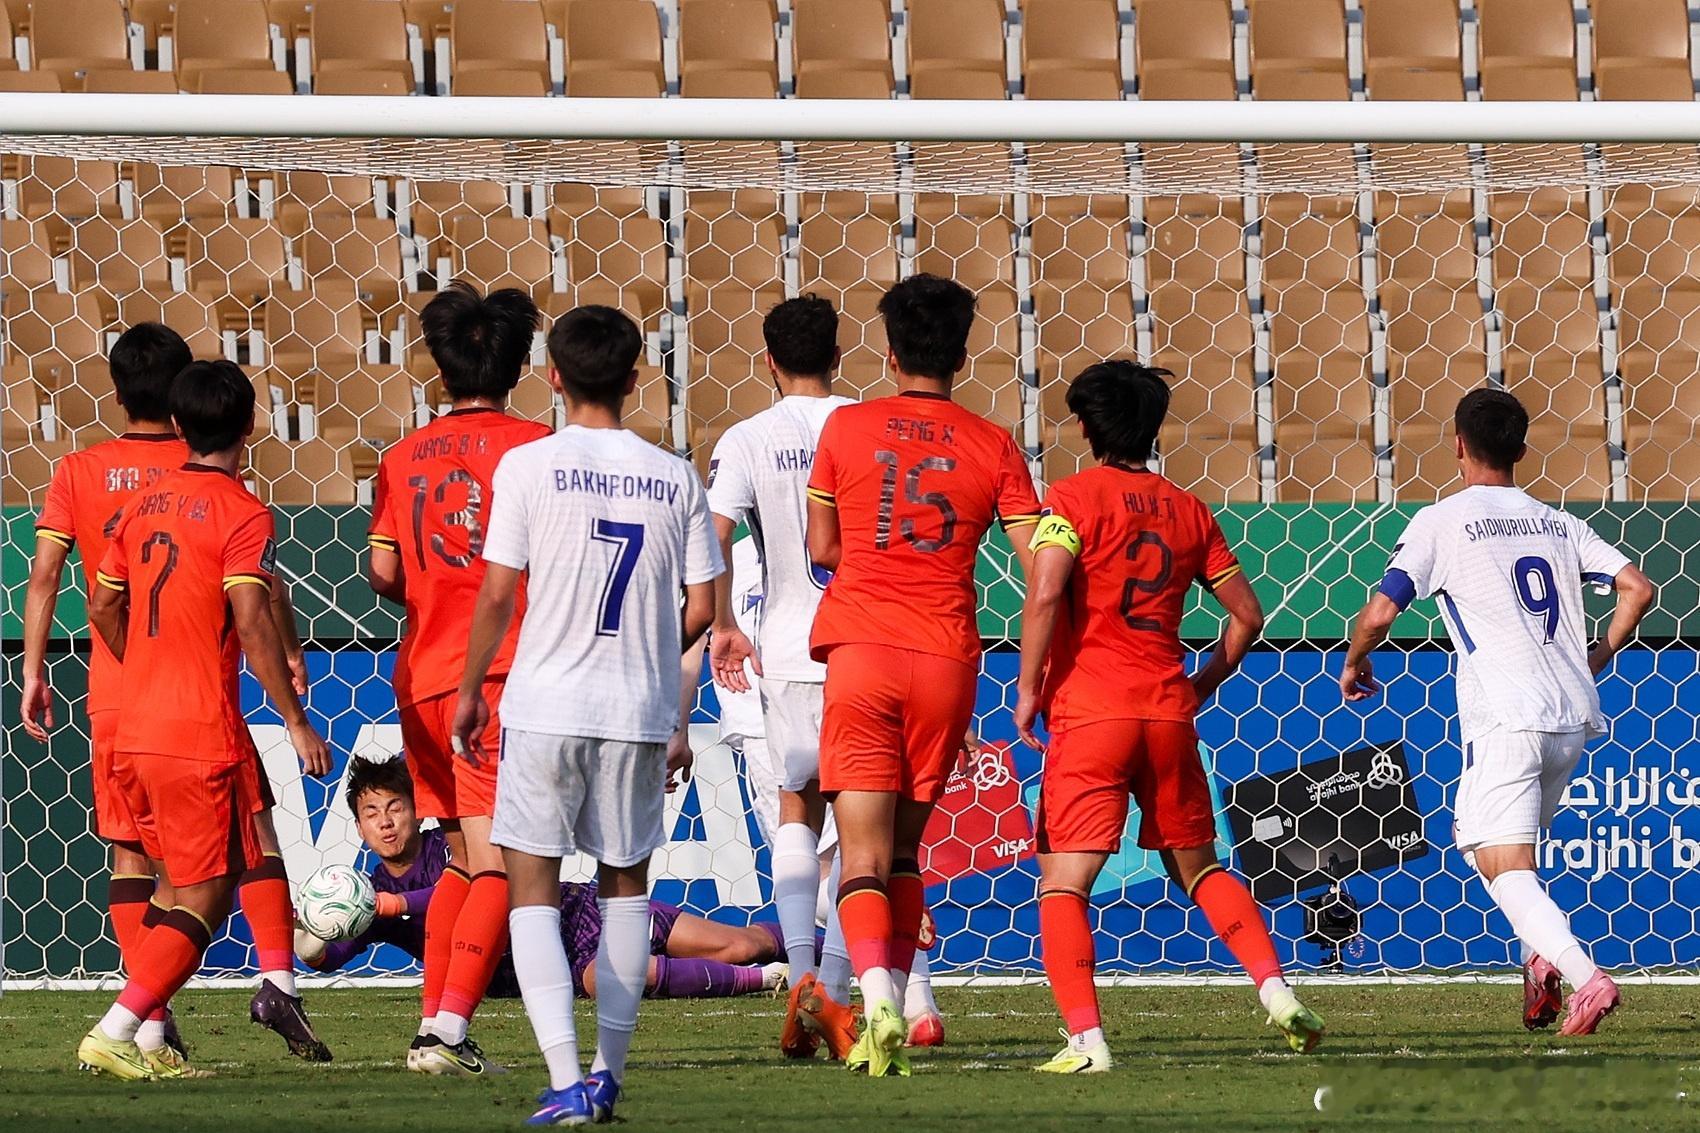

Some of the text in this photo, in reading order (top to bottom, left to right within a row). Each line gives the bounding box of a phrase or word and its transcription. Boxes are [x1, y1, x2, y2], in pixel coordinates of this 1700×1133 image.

[411, 434, 454, 461] WANG
[886, 418, 934, 442] PENG
[554, 468, 679, 506] BAKHROMOV
[874, 450, 957, 552] 15
[408, 469, 481, 572] 13
[1041, 523, 1077, 544] AFC
[1464, 517, 1568, 541] SAIDNURULLAYEV
[141, 531, 179, 638] 7
[590, 517, 645, 637] 7
[1119, 530, 1173, 631] 2
[1510, 556, 1559, 645] 9
[944, 781, 968, 795] bank
[242, 723, 762, 907] VA
[990, 838, 1029, 859] VISA
[1385, 830, 1420, 850] VISA
[1535, 825, 1650, 883] lrajhi
